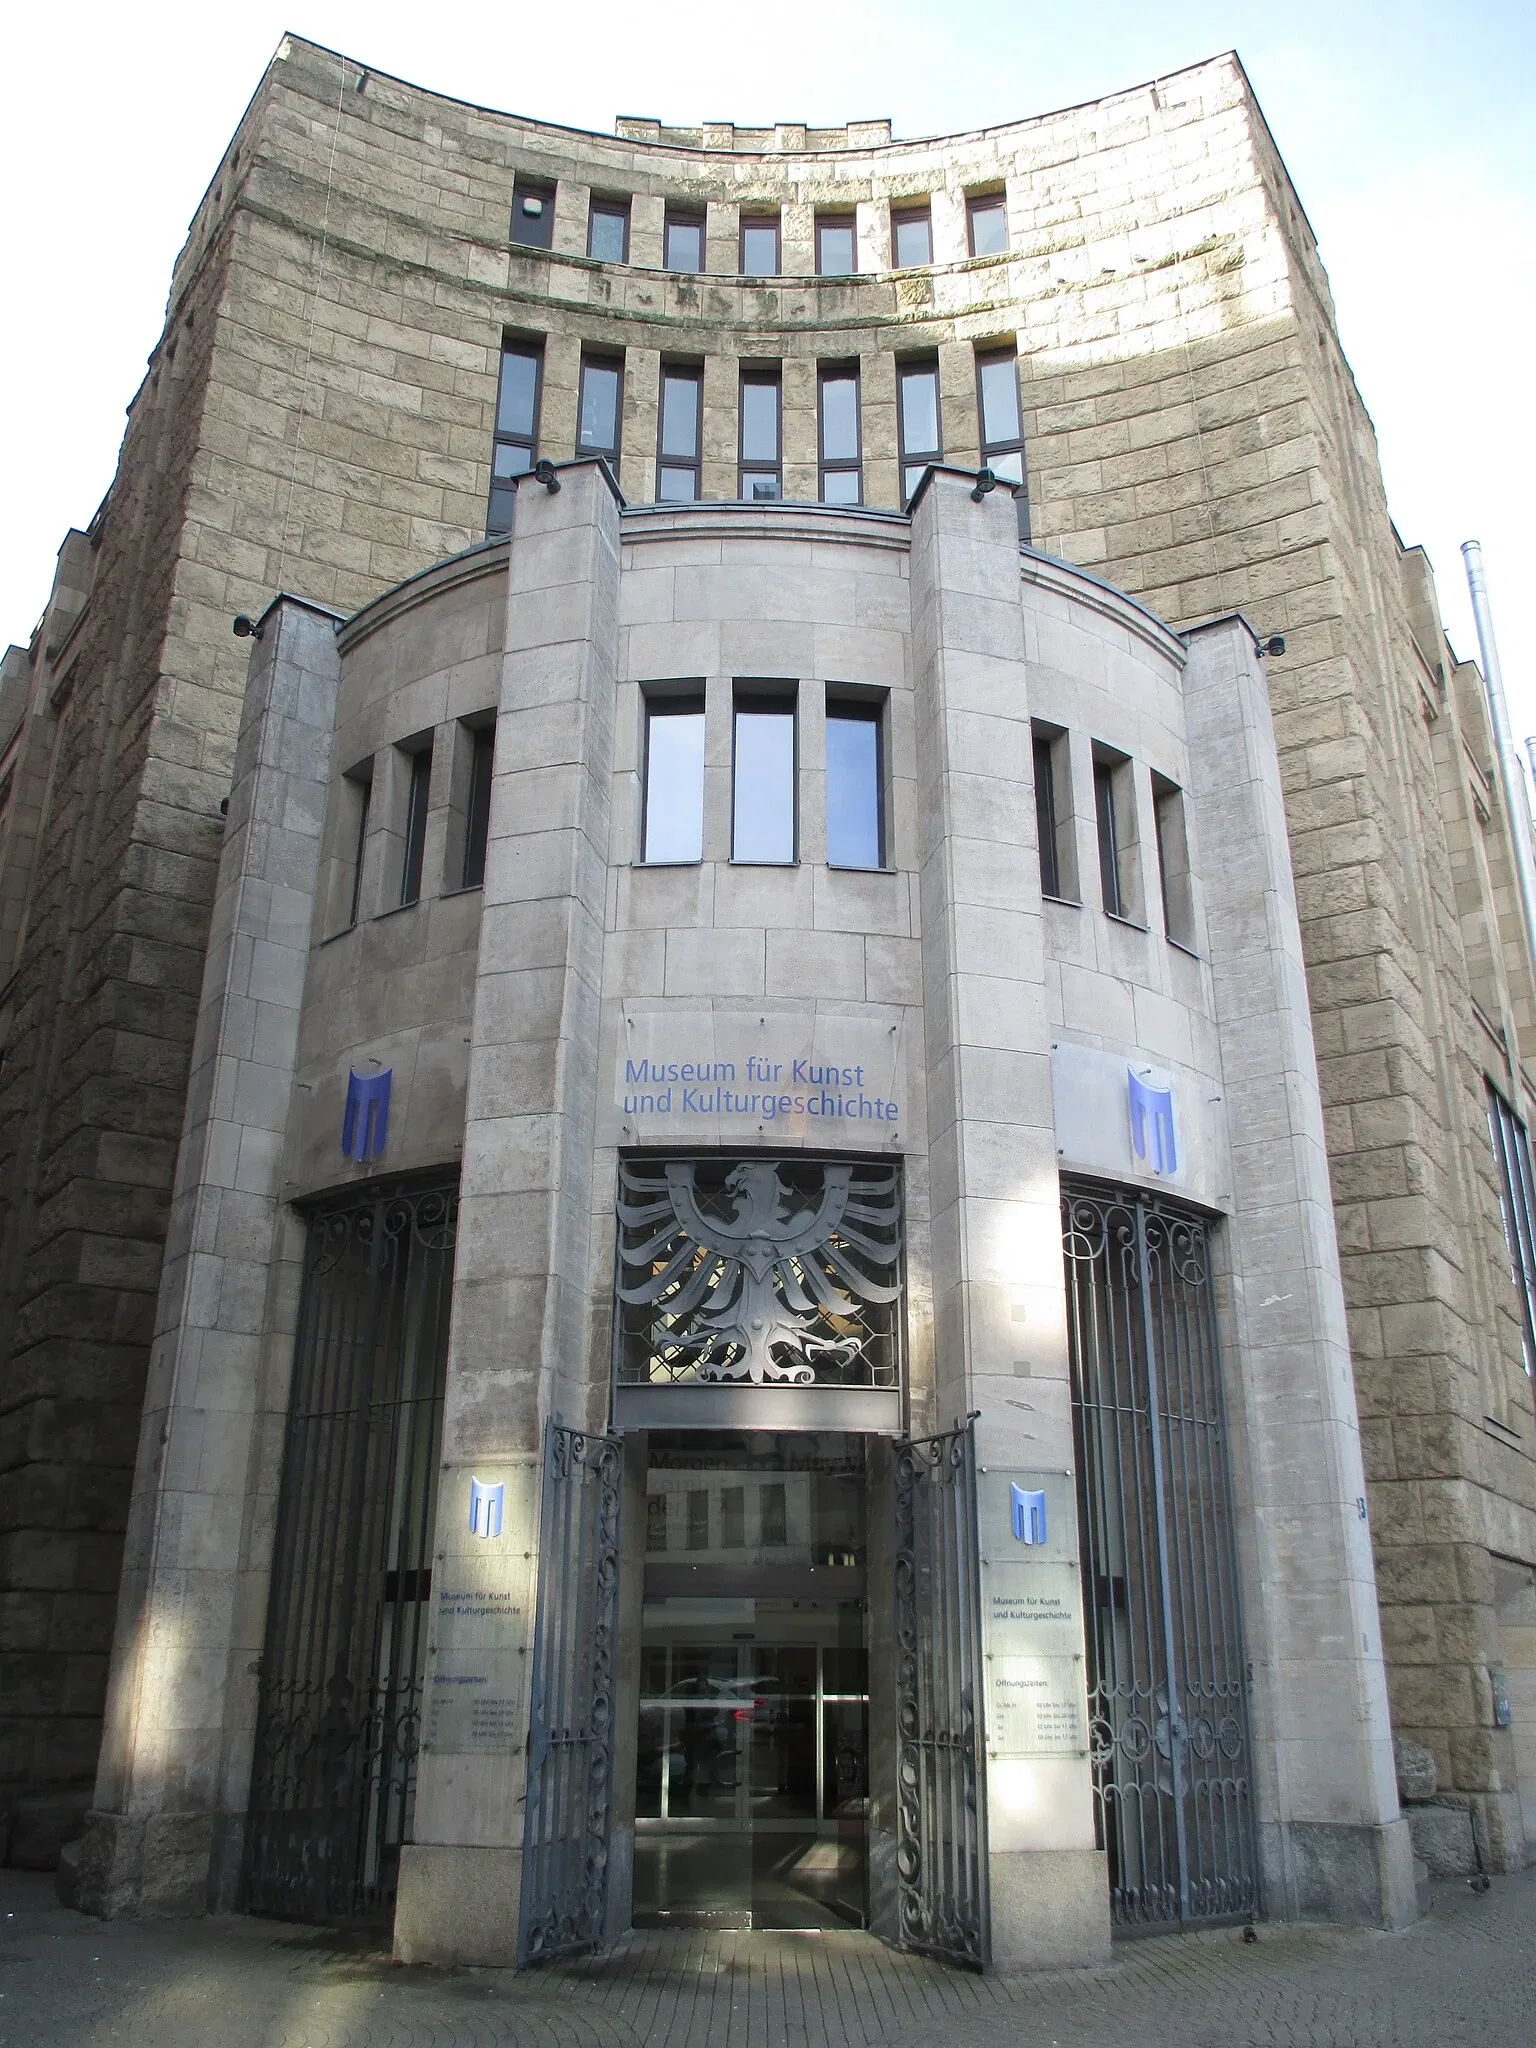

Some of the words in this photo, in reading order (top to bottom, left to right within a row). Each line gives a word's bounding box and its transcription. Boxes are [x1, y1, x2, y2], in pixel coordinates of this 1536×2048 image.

[625, 1059, 736, 1083] Museum
[746, 1056, 783, 1083] für
[792, 1059, 865, 1087] Kunst
[623, 1088, 672, 1114] und
[682, 1086, 900, 1121] Kulturgeschichte
[440, 1591, 473, 1601] Museum
[475, 1591, 487, 1601] für
[488, 1591, 511, 1601] Kunst
[992, 1596, 1025, 1605] Museum
[1027, 1596, 1037, 1605] für
[1039, 1597, 1061, 1605] Kunst
[438, 1606, 454, 1614] und
[456, 1605, 521, 1616] Kulturgeschichte
[993, 1610, 1008, 1619] und
[1010, 1610, 1072, 1620] Kulturgeschichte
